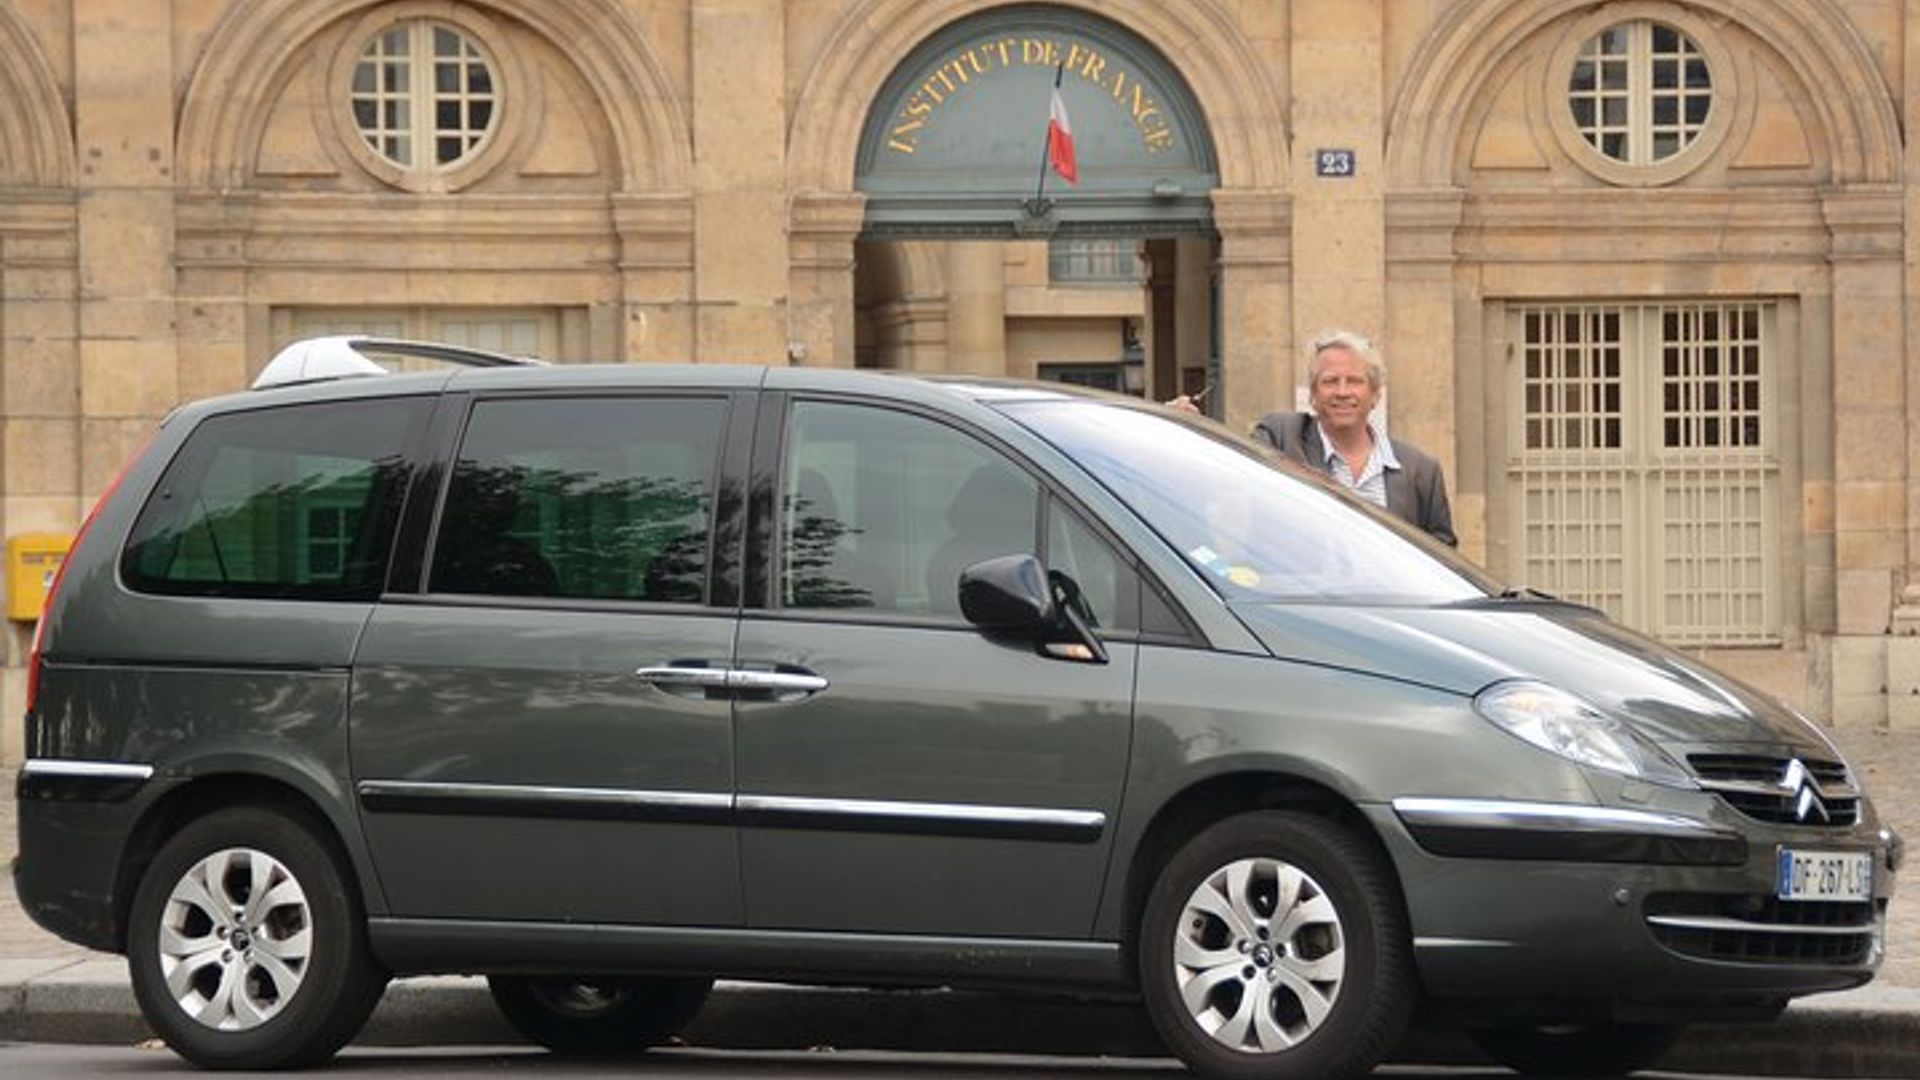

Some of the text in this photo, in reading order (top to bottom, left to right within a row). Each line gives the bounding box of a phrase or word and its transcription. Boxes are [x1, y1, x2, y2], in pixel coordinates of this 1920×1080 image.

[888, 38, 1174, 154] INSTITUT DE FRANCE
[1322, 153, 1349, 174] 23
